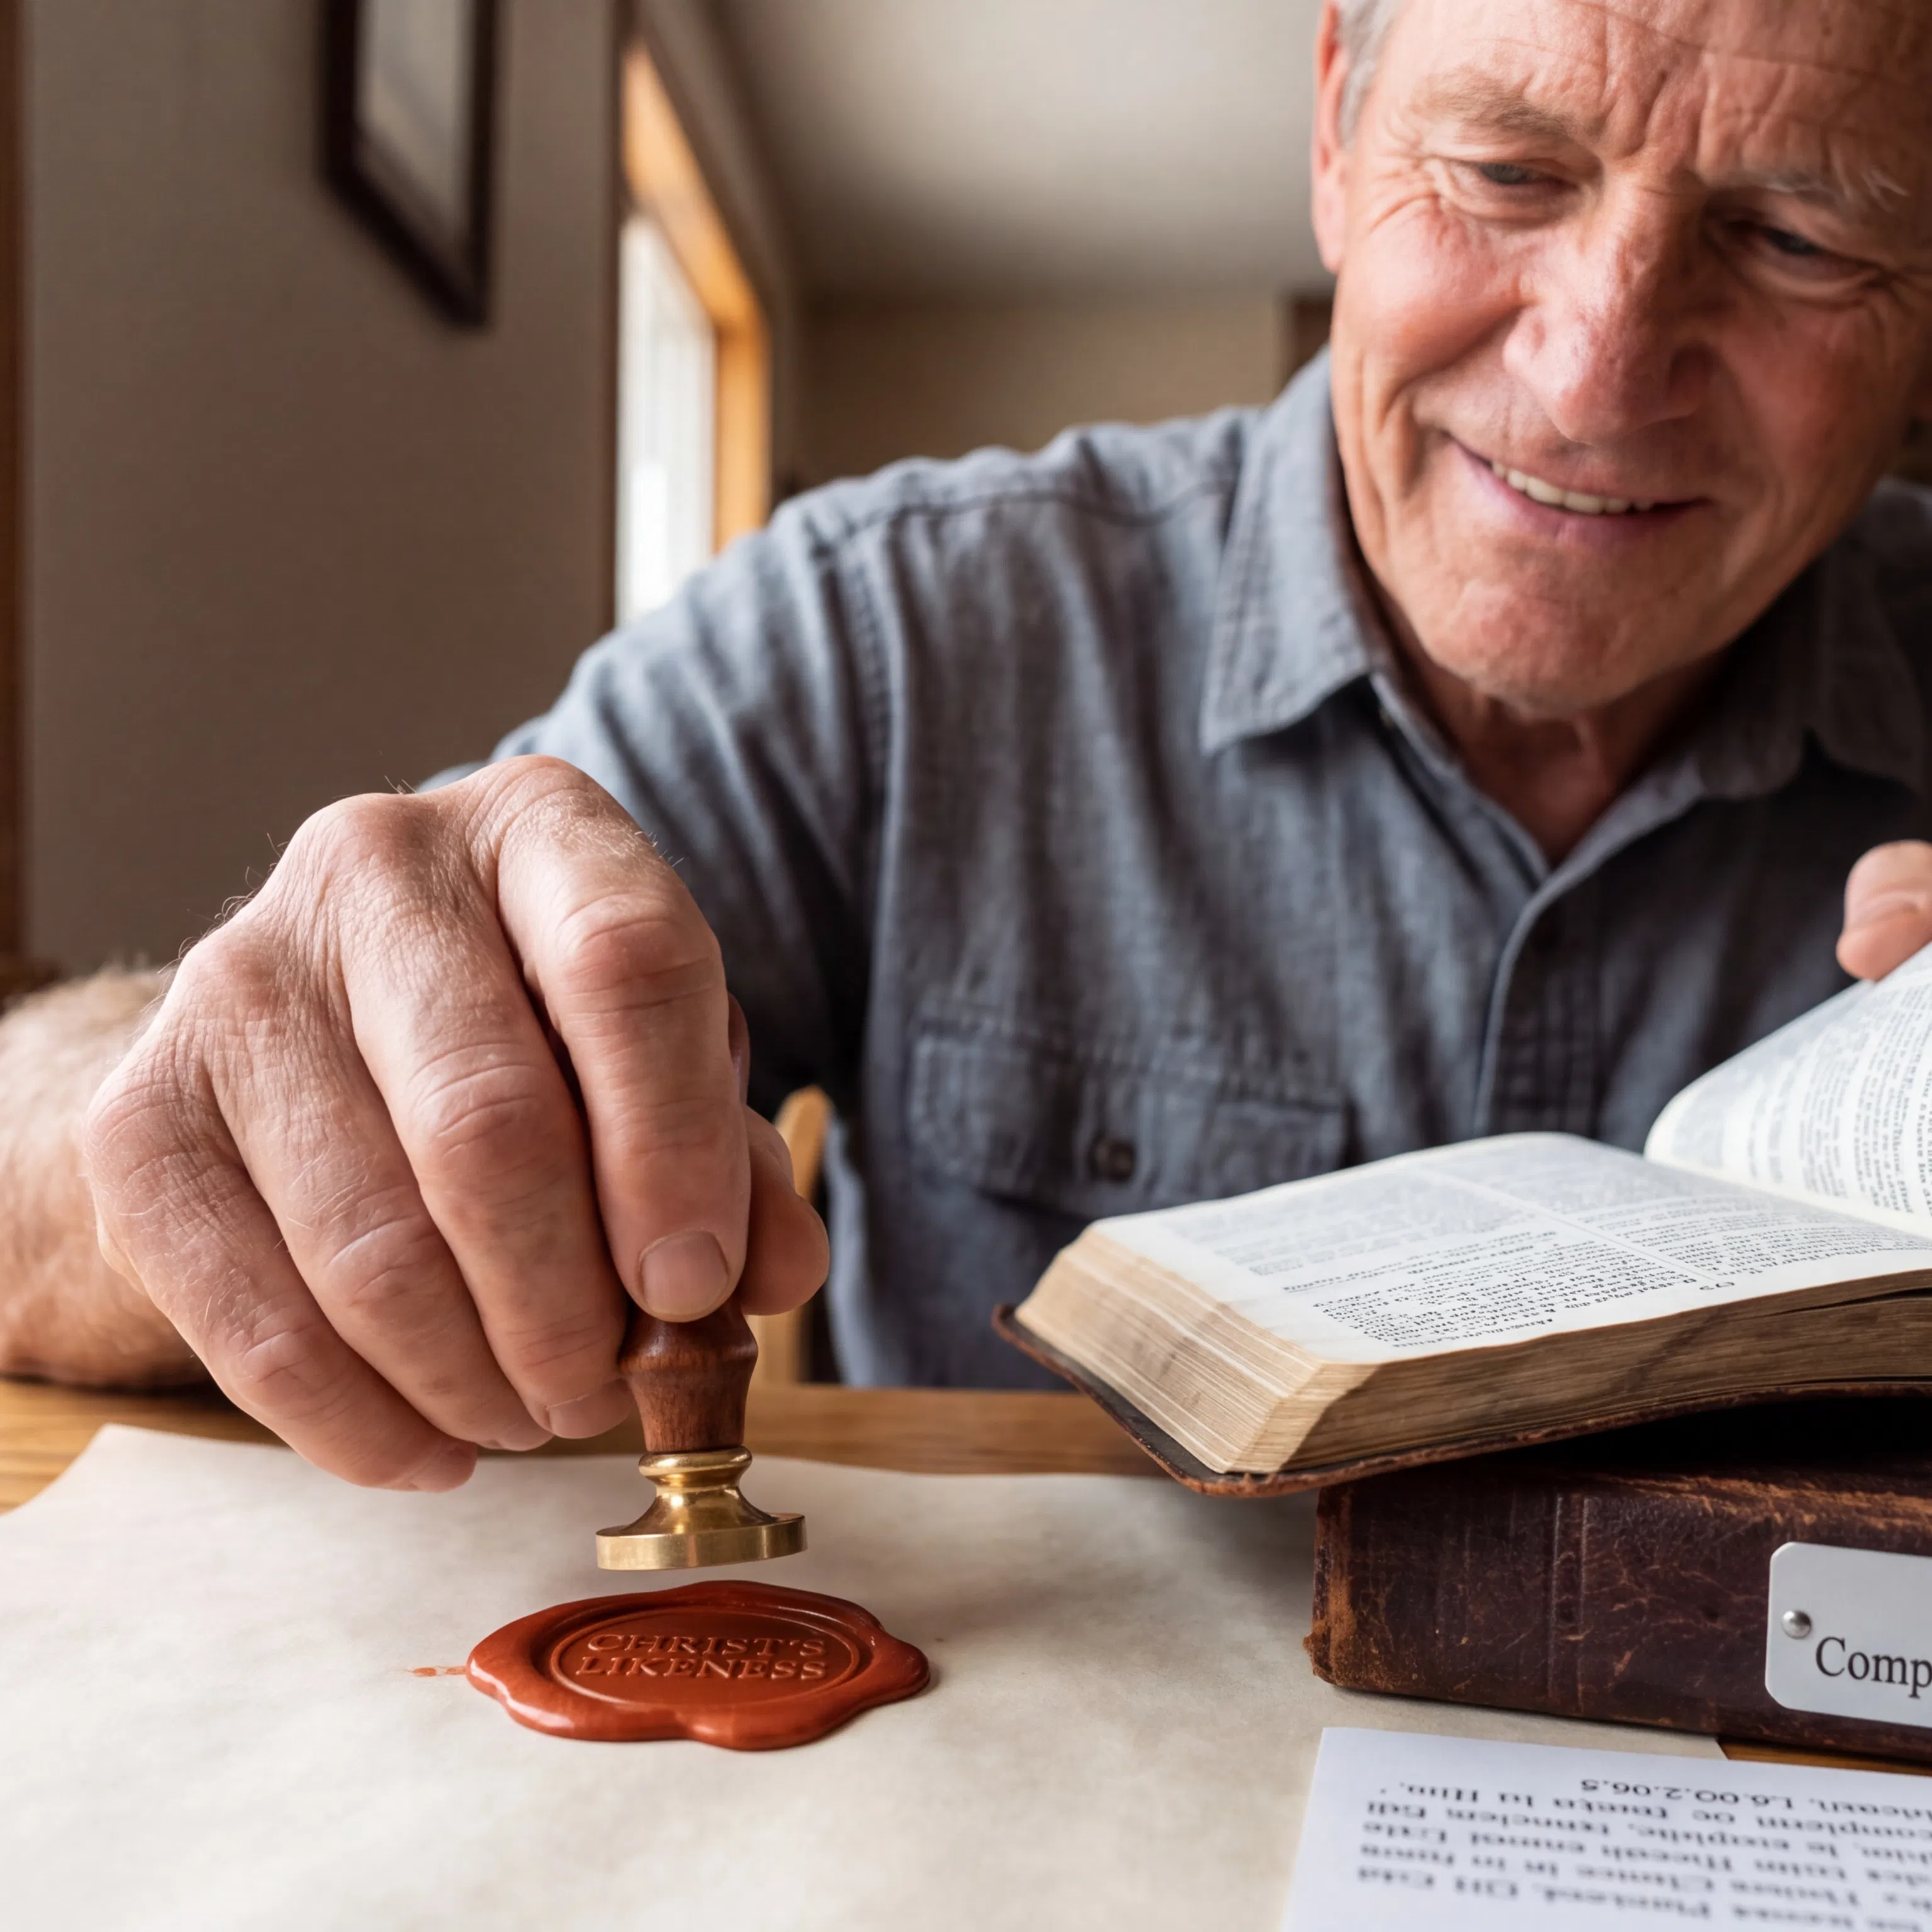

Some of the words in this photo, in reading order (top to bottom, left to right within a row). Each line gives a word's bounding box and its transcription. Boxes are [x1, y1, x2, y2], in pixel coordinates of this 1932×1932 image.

[586, 1633, 827, 1657] CHRIST'S
[575, 1657, 828, 1680] LIKENESS
[1816, 1636, 1932, 1699] Comp
